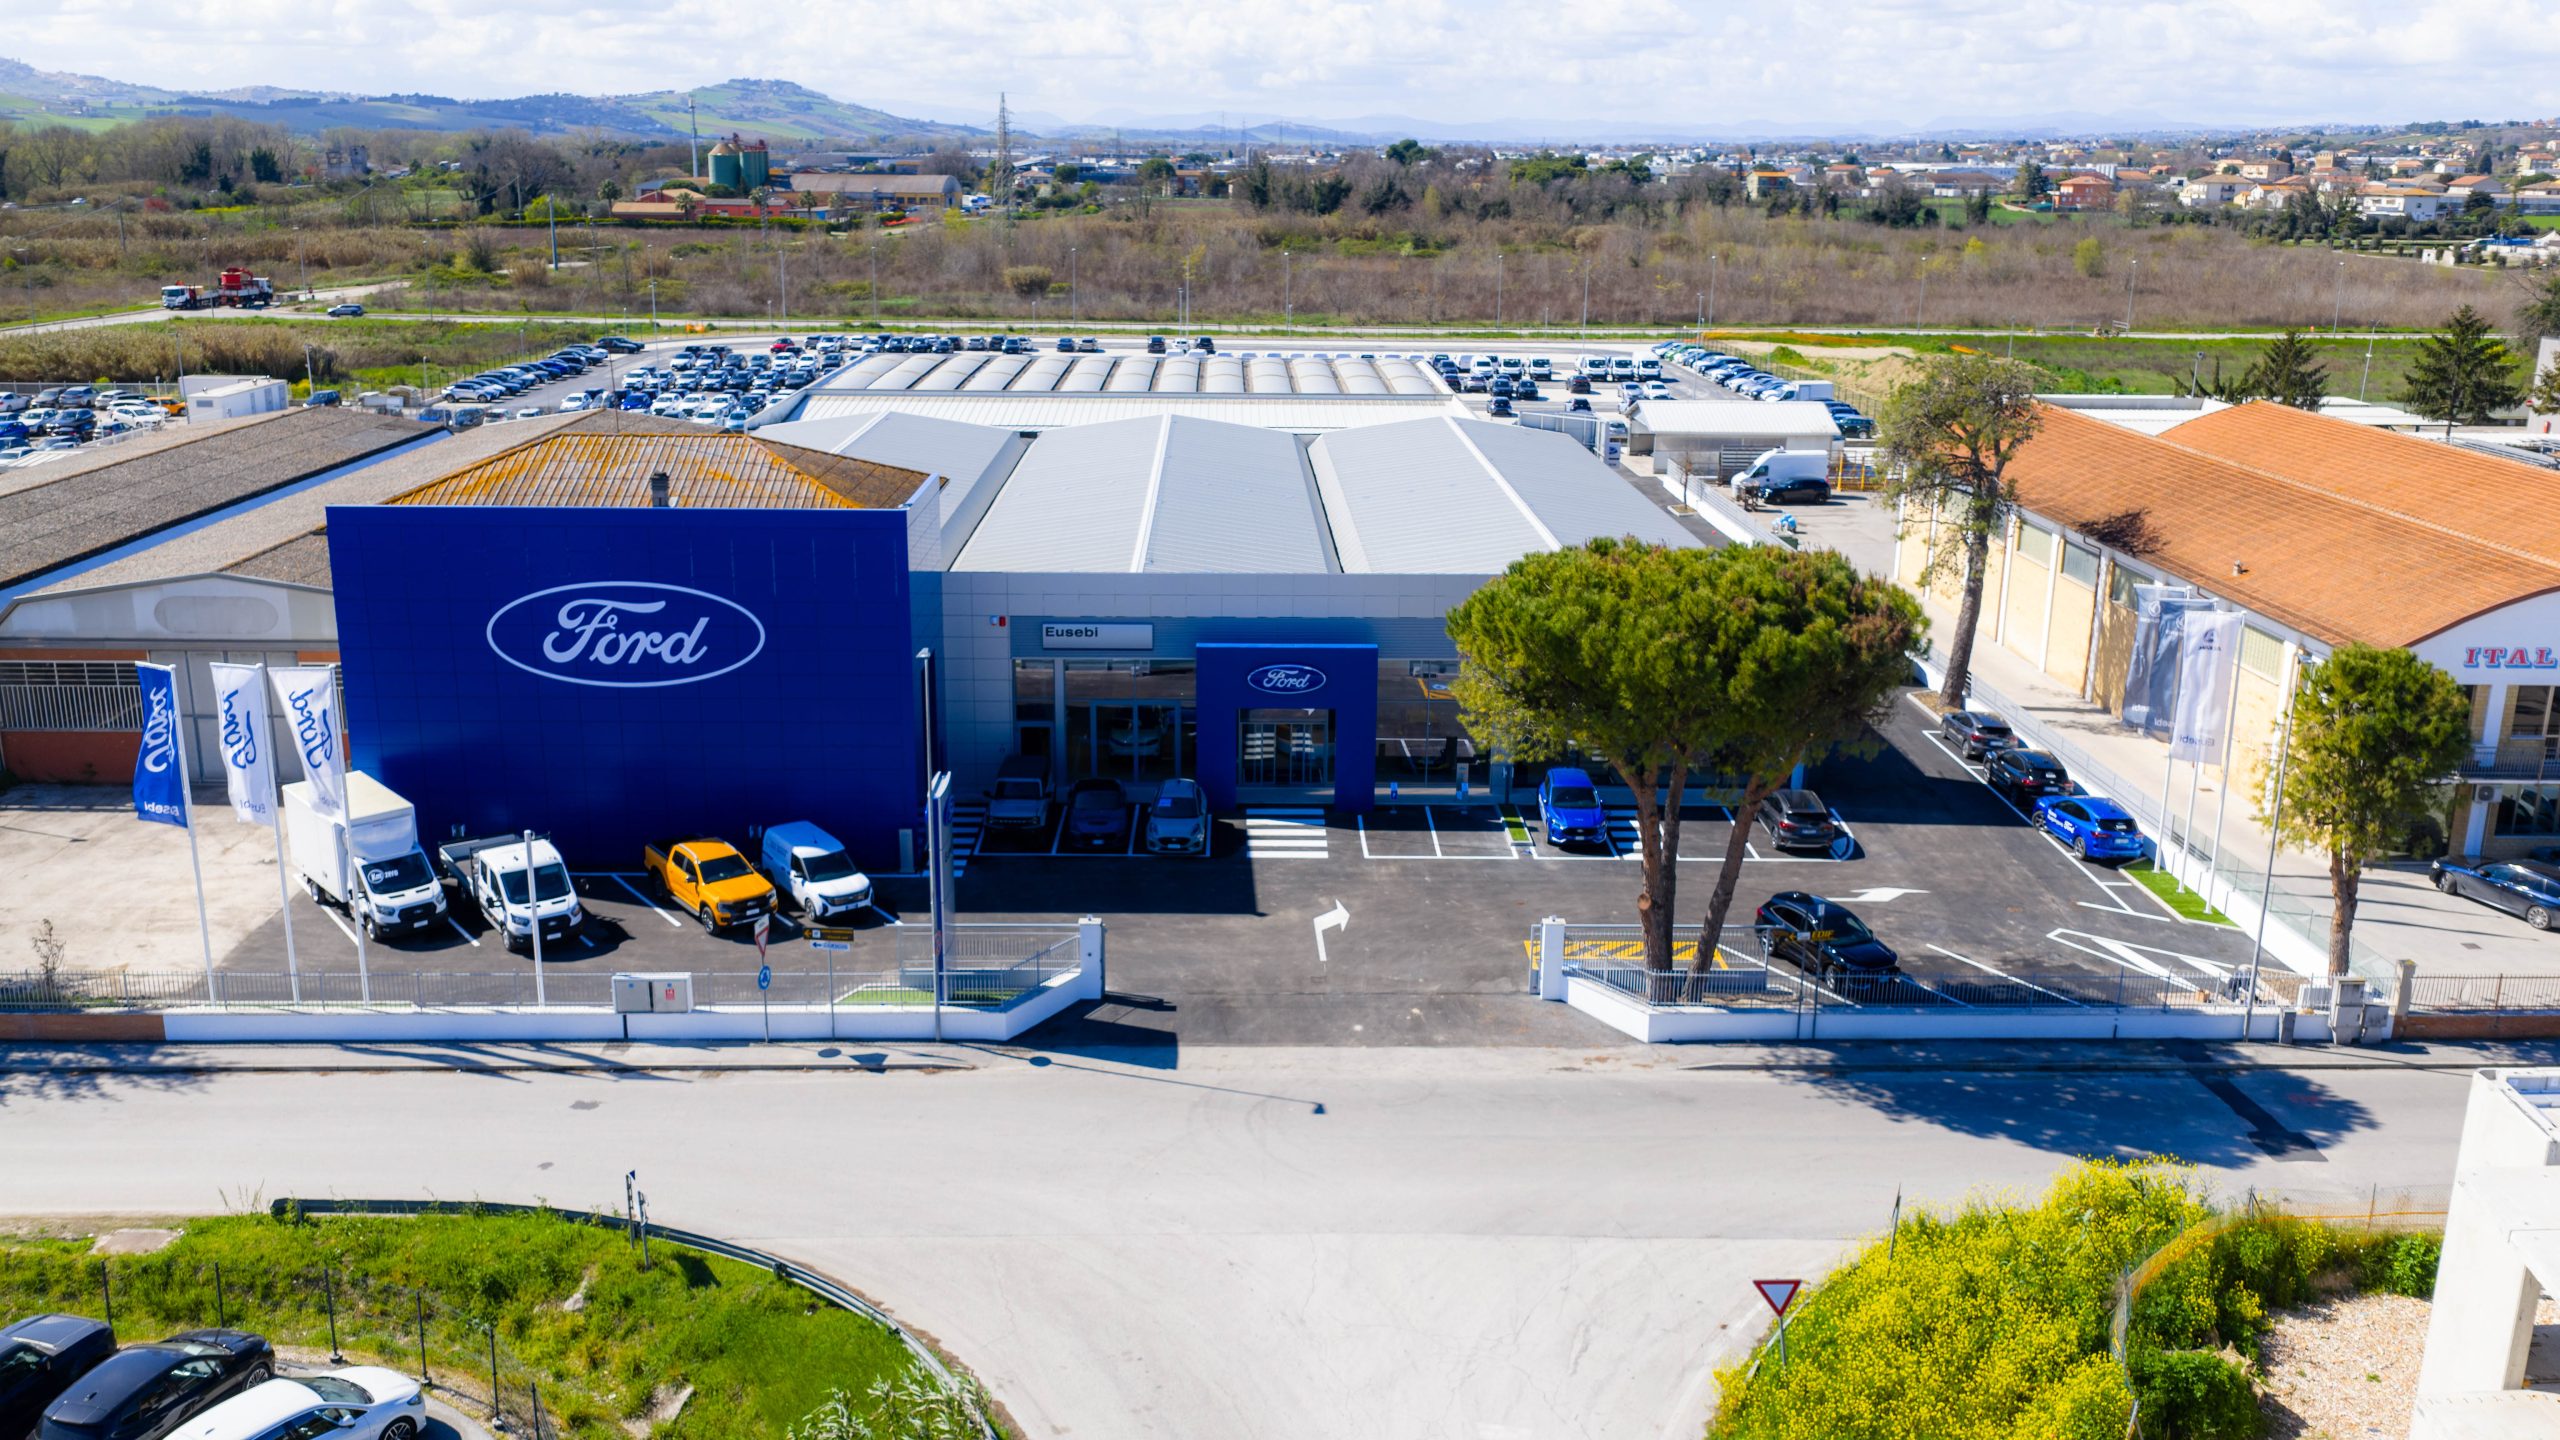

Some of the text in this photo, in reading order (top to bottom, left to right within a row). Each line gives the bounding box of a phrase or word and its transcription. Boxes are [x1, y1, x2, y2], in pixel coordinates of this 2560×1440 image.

[543, 598, 710, 664] Ford
[1045, 626, 1098, 638] Eusebi
[2463, 647, 2558, 668] ITAL
[1262, 668, 1311, 688] Ford
